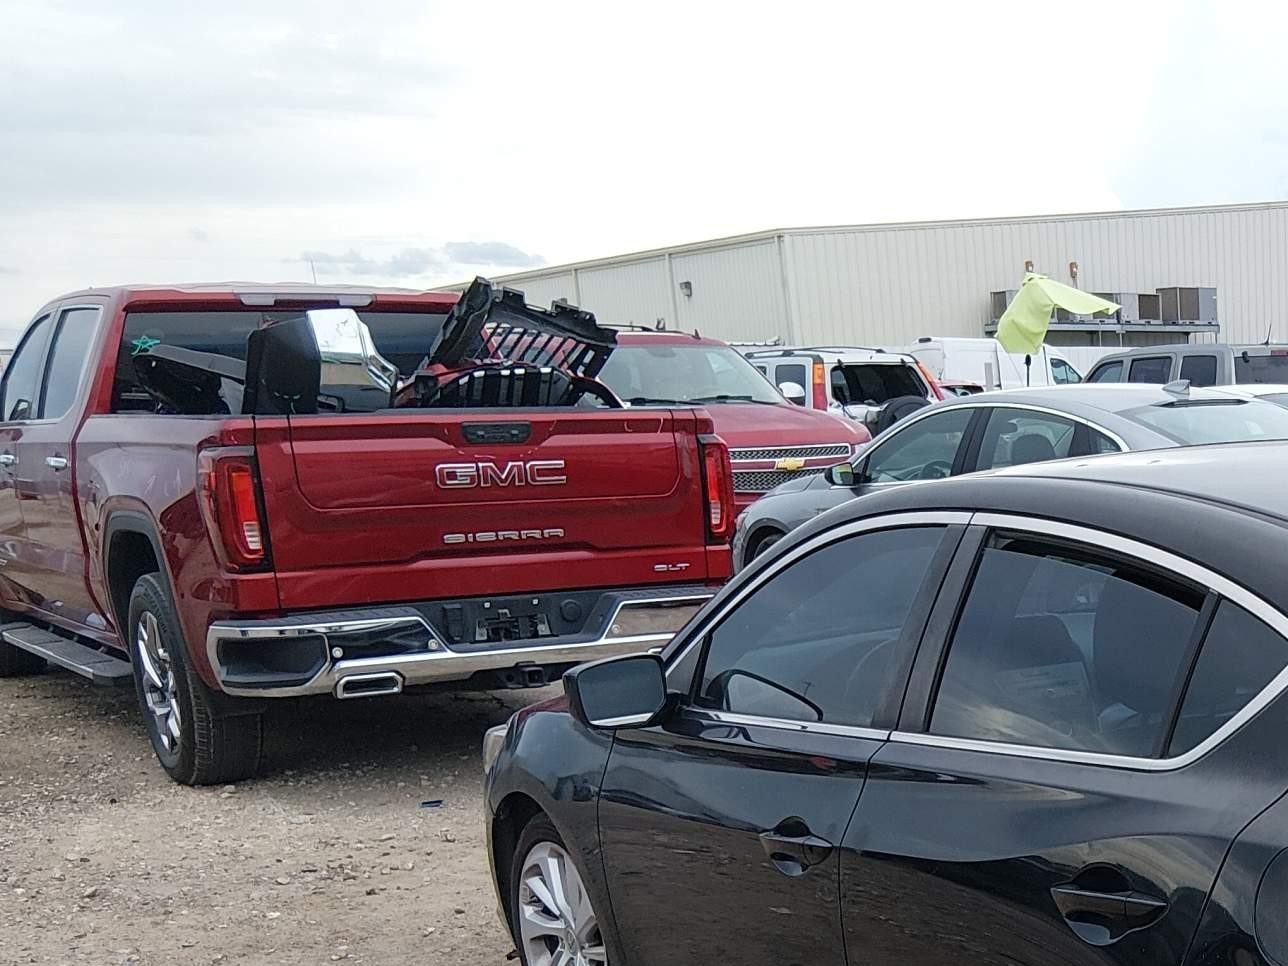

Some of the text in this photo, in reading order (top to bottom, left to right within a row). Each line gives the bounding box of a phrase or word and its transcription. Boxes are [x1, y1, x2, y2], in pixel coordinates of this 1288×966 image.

[435, 459, 567, 489] GMC
[443, 528, 565, 544] SIERRA
[654, 562, 691, 571] SLT
